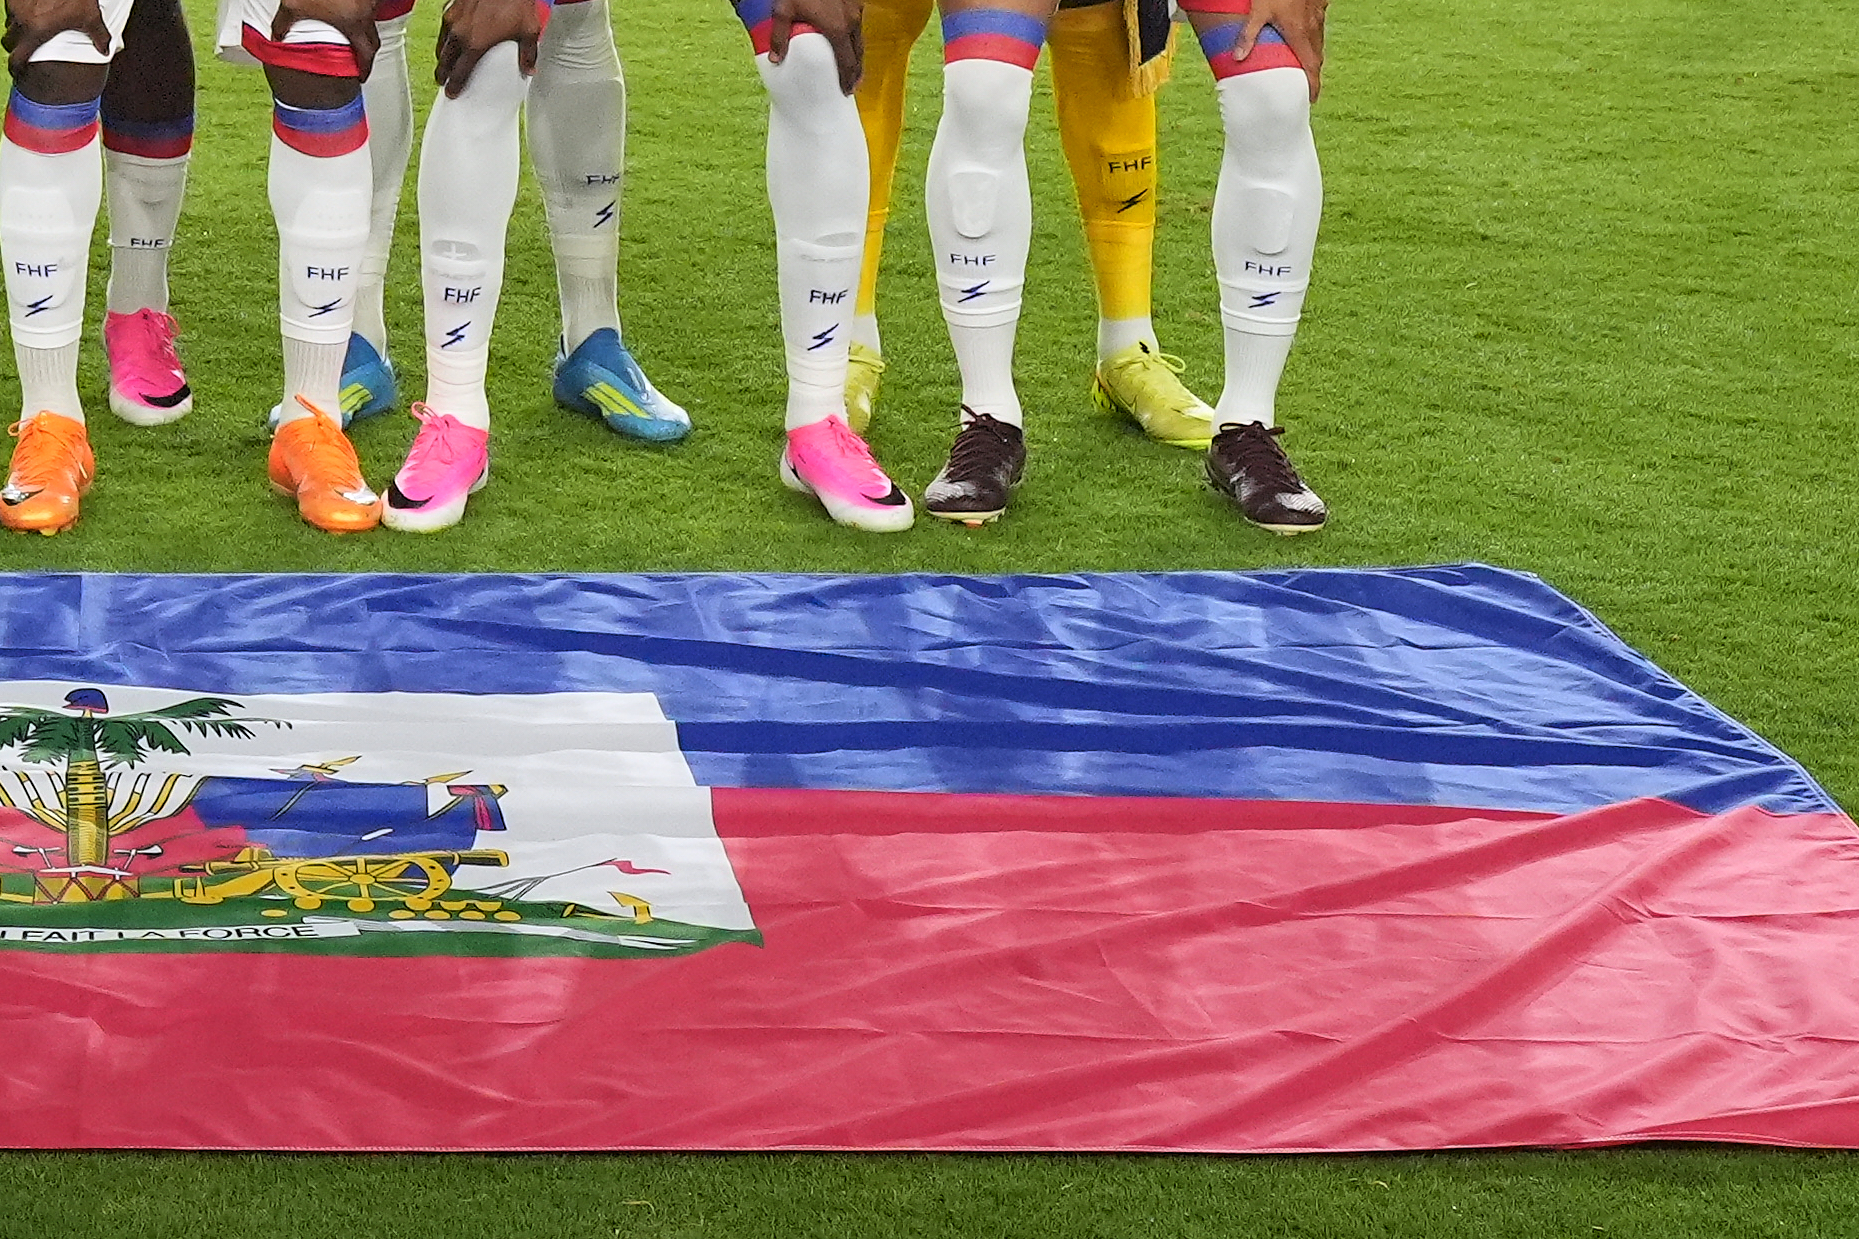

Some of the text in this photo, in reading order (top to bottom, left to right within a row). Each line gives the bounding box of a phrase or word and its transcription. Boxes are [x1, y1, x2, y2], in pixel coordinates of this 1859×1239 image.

[1108, 156, 1152, 173] FHF
[950, 253, 996, 266] FHF
[15, 262, 57, 277] FHF
[307, 266, 349, 281] FHF
[1245, 261, 1291, 277] FHF
[444, 287, 482, 303] FHF
[809, 289, 848, 304] FHF
[22, 930, 104, 941] FAIT
[179, 925, 319, 939] FORCE
